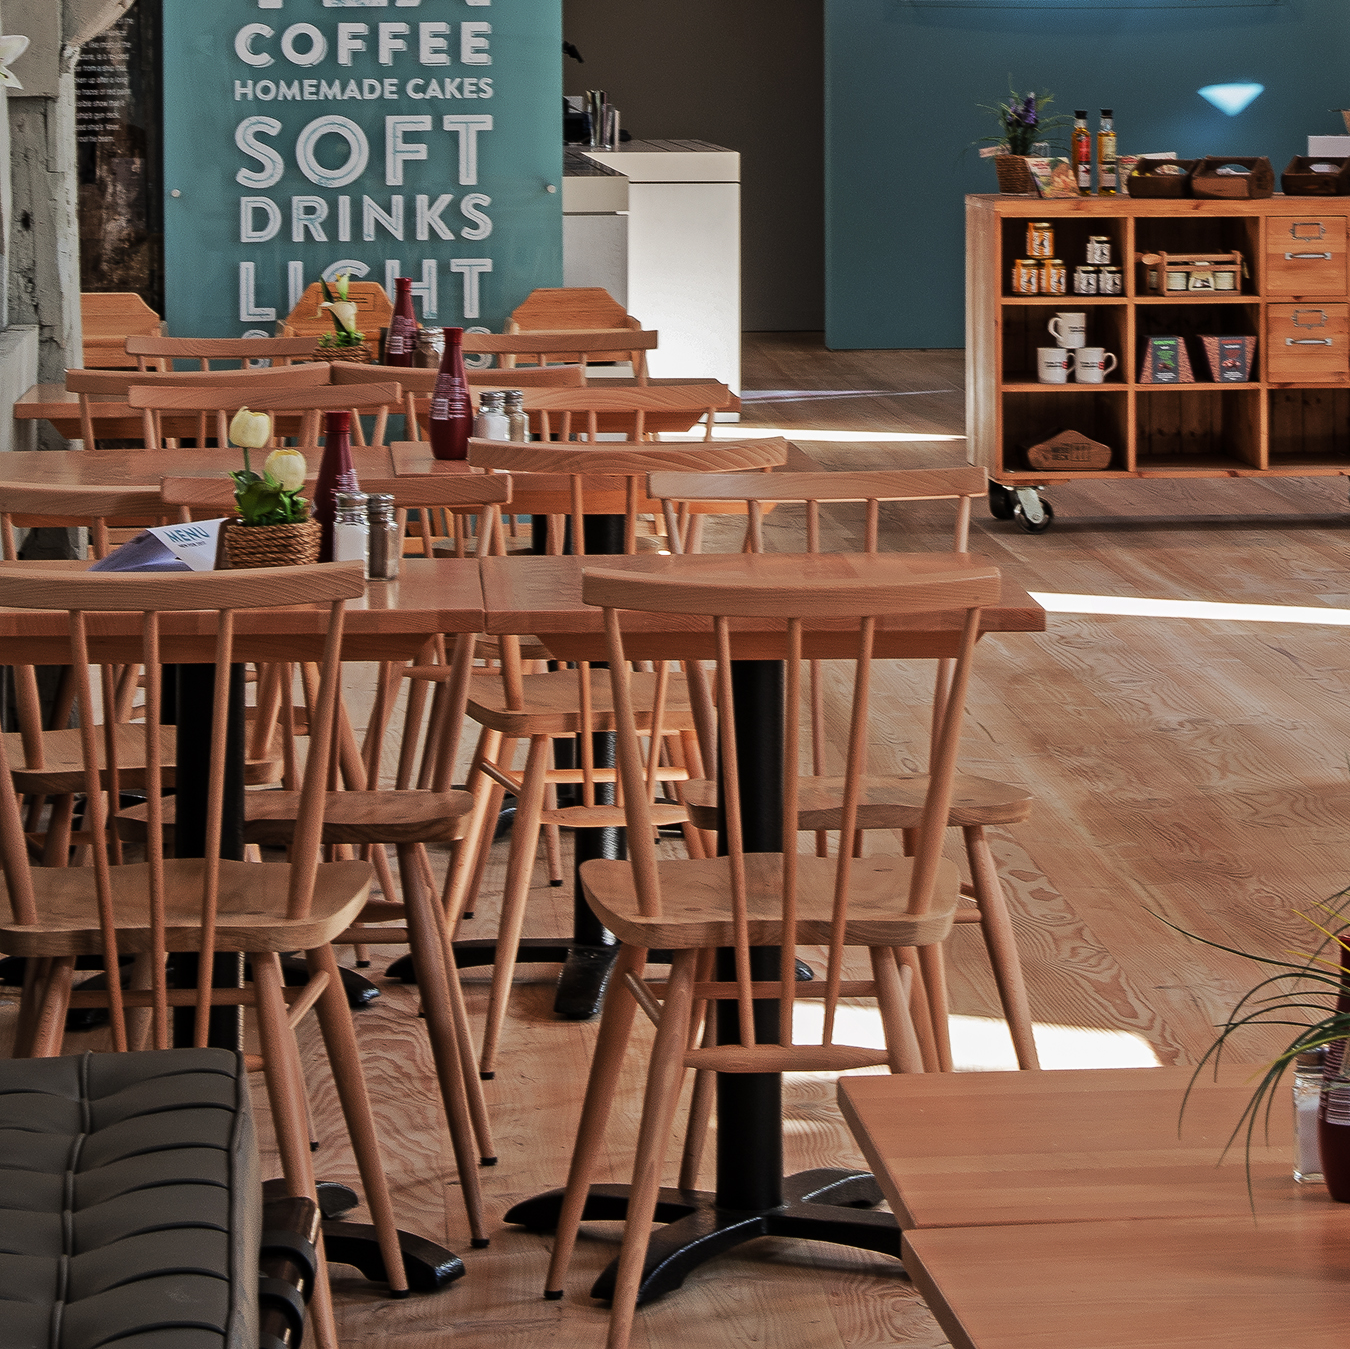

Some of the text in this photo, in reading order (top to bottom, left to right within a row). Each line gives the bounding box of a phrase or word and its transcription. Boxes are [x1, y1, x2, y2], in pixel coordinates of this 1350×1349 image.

[234, 21, 493, 68] COFFEE
[234, 77, 494, 101] HOMEMADE CAKES
[234, 114, 494, 189] SOFT
[239, 193, 494, 243] DRINKS
[162, 526, 210, 543] MENU
